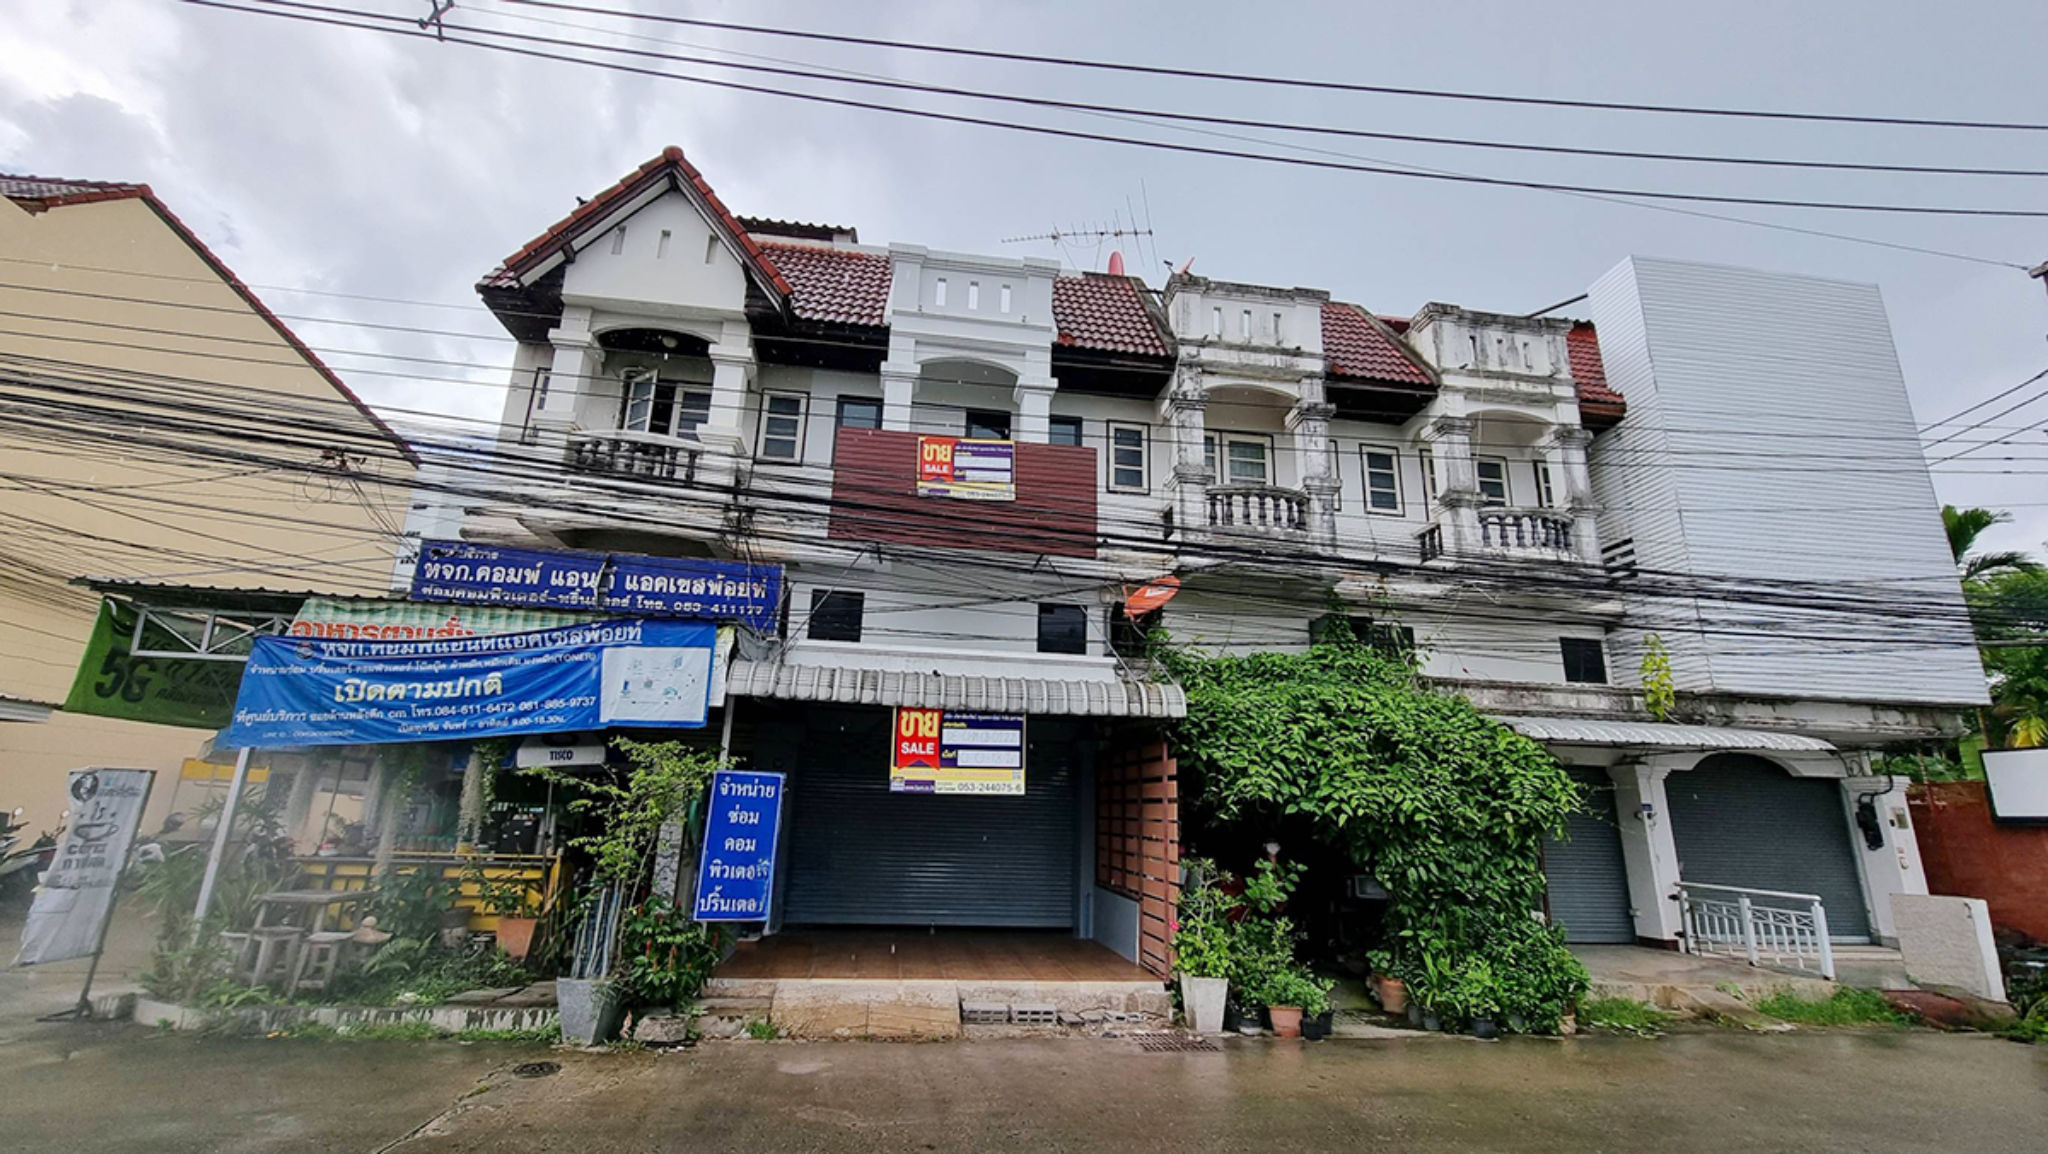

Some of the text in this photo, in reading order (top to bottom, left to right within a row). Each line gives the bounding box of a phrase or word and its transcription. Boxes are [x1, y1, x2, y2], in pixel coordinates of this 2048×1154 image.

[924, 444, 952, 462] ขาย
[925, 464, 948, 473] SALE
[95, 646, 157, 703] 5G
[334, 671, 503, 703] เปิดตามปกติ
[900, 711, 938, 737] ขาย
[550, 750, 574, 761] TISCO
[901, 742, 935, 754] SALE
[719, 776, 776, 798] จำหน่าย
[727, 804, 760, 824] ซ่อม
[724, 837, 757, 852] คอม
